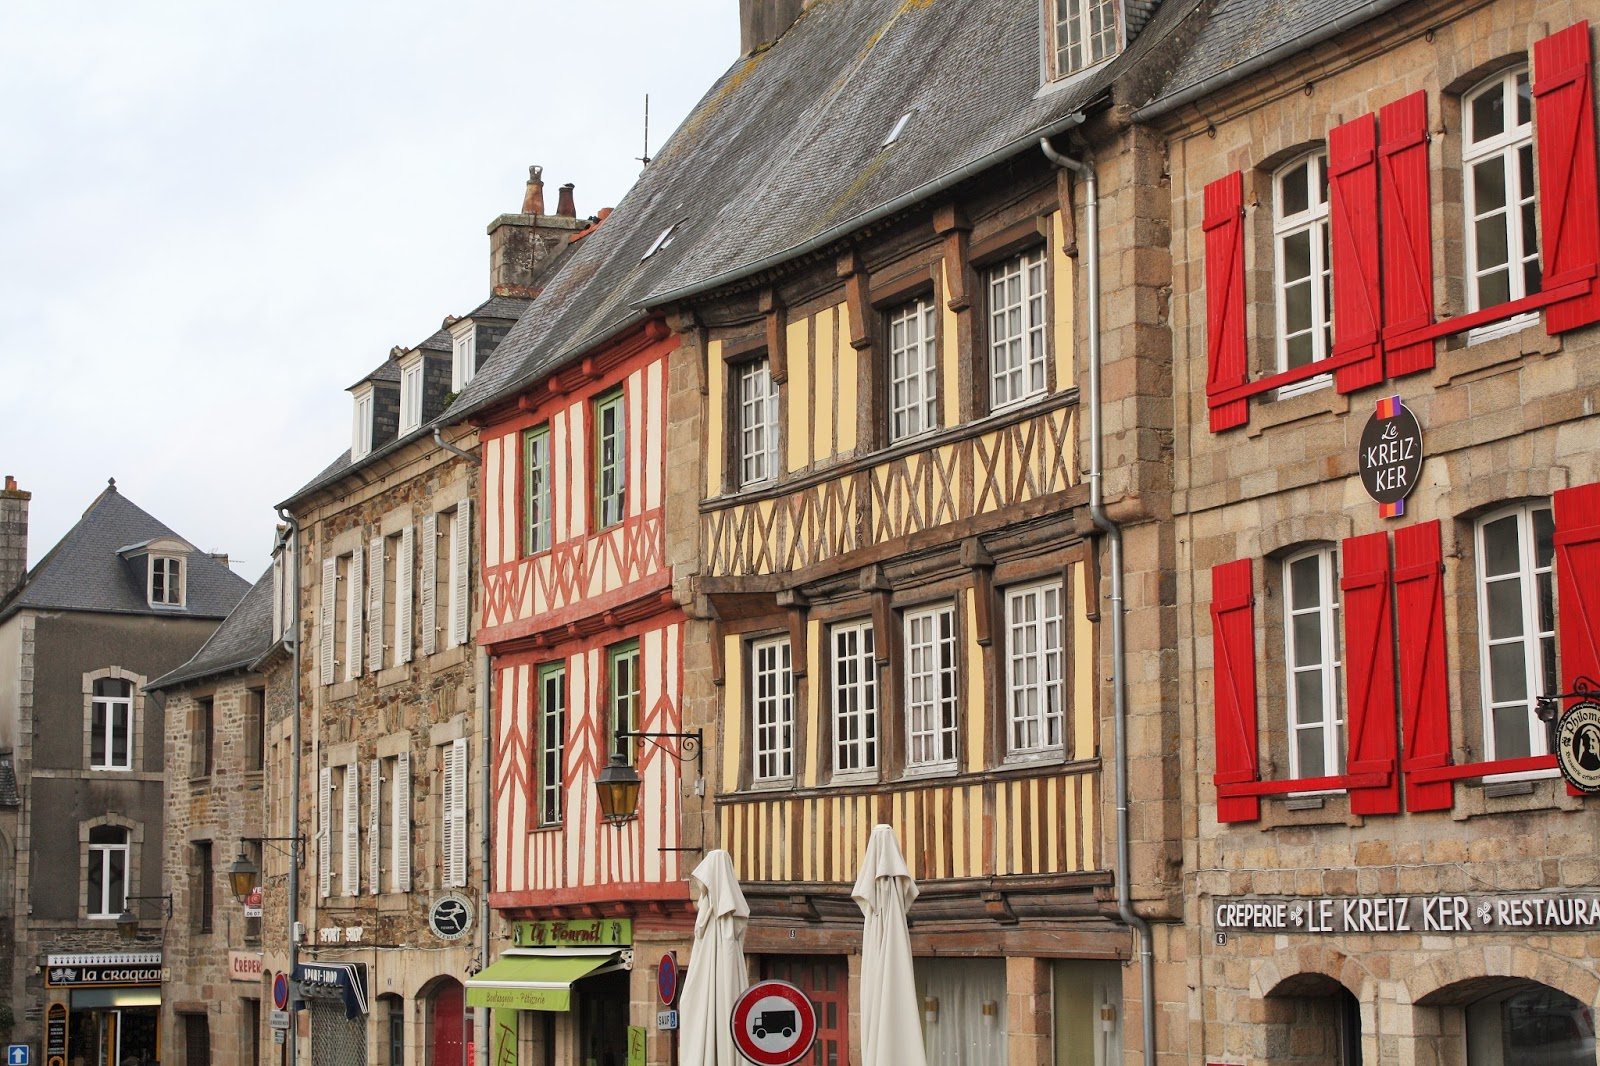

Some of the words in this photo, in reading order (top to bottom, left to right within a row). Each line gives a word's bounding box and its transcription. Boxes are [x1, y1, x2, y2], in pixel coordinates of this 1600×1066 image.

[1382, 421, 1399, 440] Le
[1366, 437, 1414, 468] KREIZ
[1375, 466, 1407, 492] KER
[1216, 904, 1287, 928] CREPERIE
[1308, 899, 1334, 932] LE
[1342, 897, 1410, 932] KREIZ
[1422, 896, 1472, 932] KER
[658, 1015, 670, 1026] SAUF
